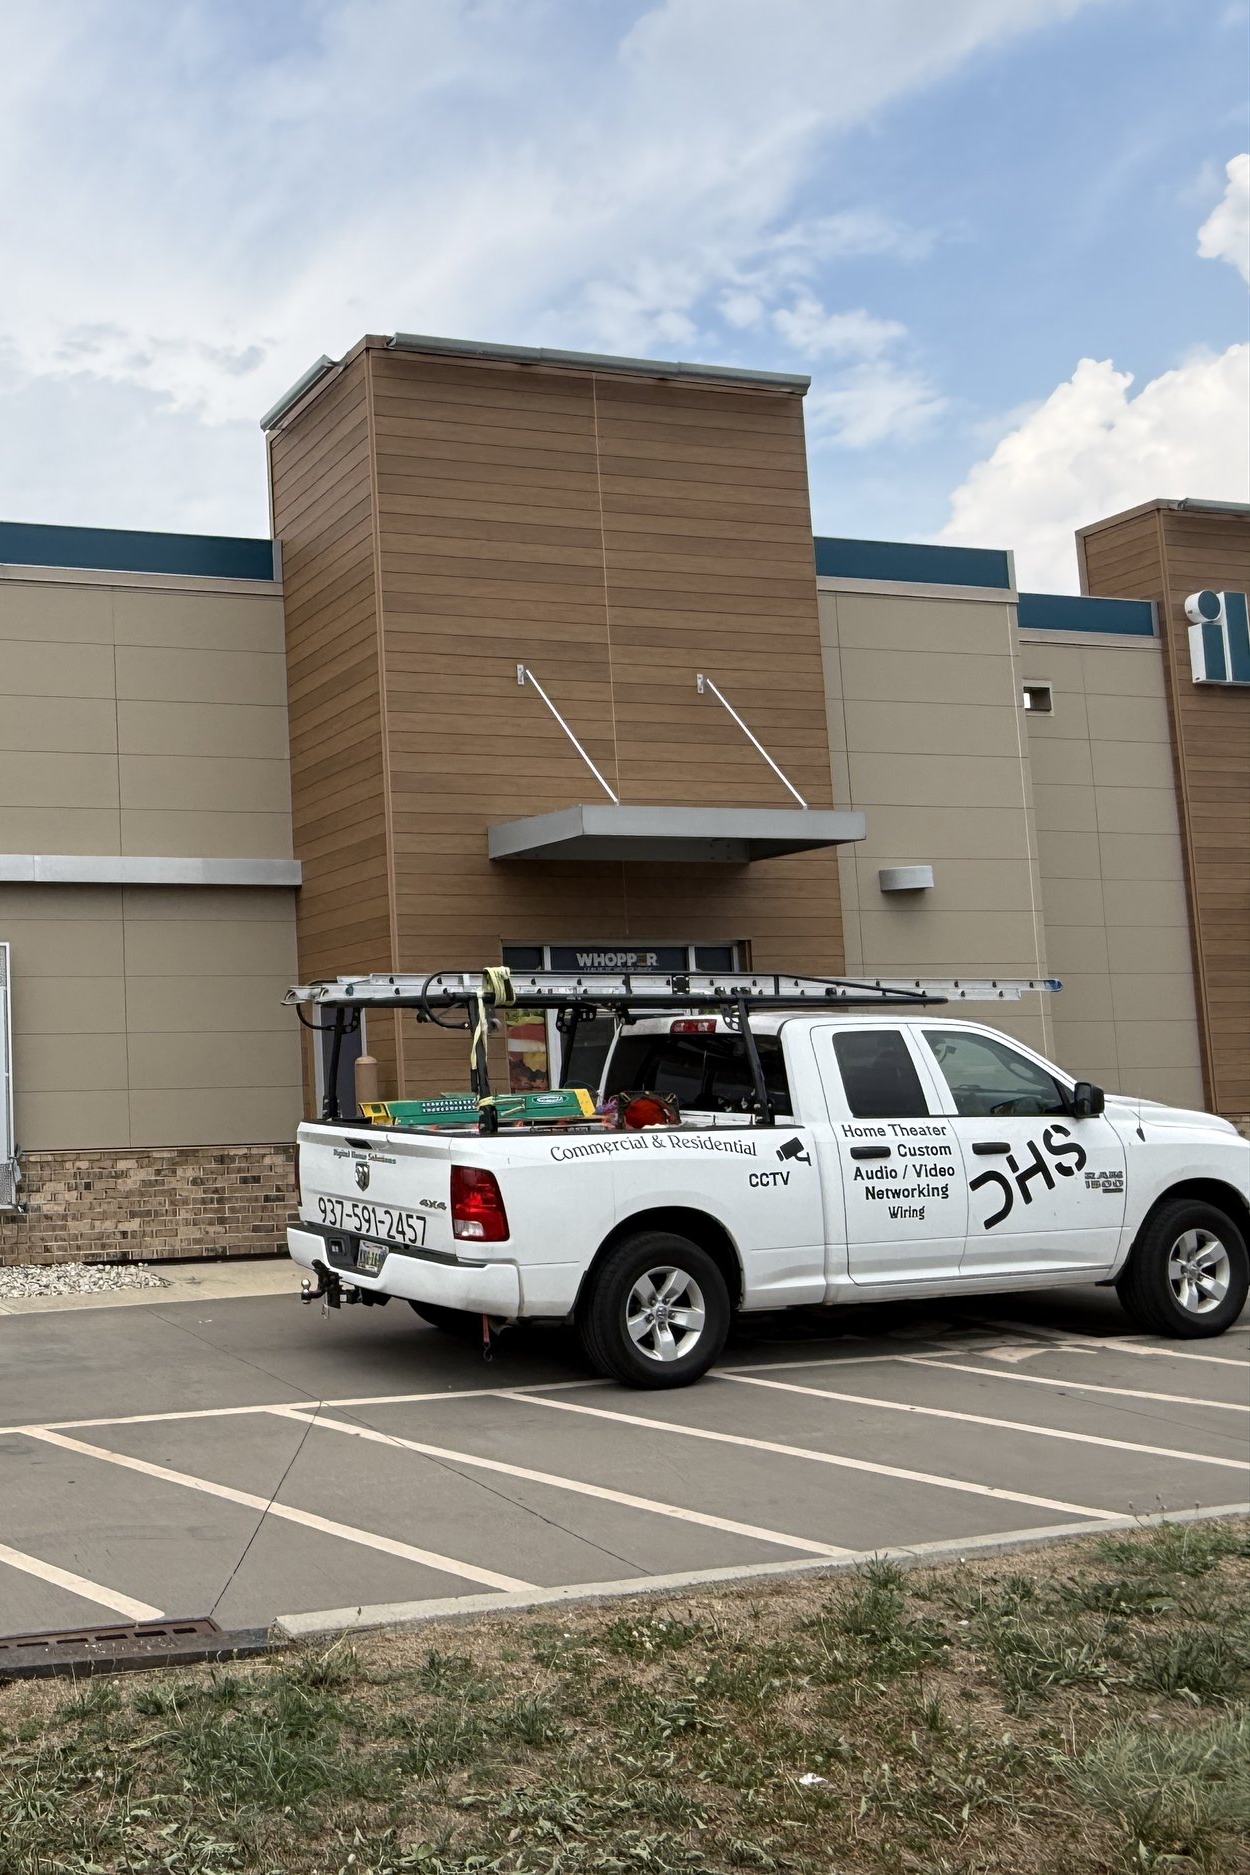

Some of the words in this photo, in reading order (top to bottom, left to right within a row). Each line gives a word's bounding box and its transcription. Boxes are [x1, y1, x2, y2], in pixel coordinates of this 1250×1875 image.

[841, 1124, 886, 1137] Home
[887, 1123, 946, 1136] Theater
[550, 1136, 649, 1161] Commercial
[652, 1134, 666, 1149] &
[667, 1134, 758, 1156] Residential
[897, 1144, 952, 1157] Custom
[749, 1171, 790, 1187] CCTV
[853, 1165, 898, 1180] Audio
[912, 1163, 955, 1177] Video
[865, 1183, 949, 1200] Networking
[888, 1205, 925, 1220] Wiring
[318, 1197, 427, 1246] 937-591-2457
